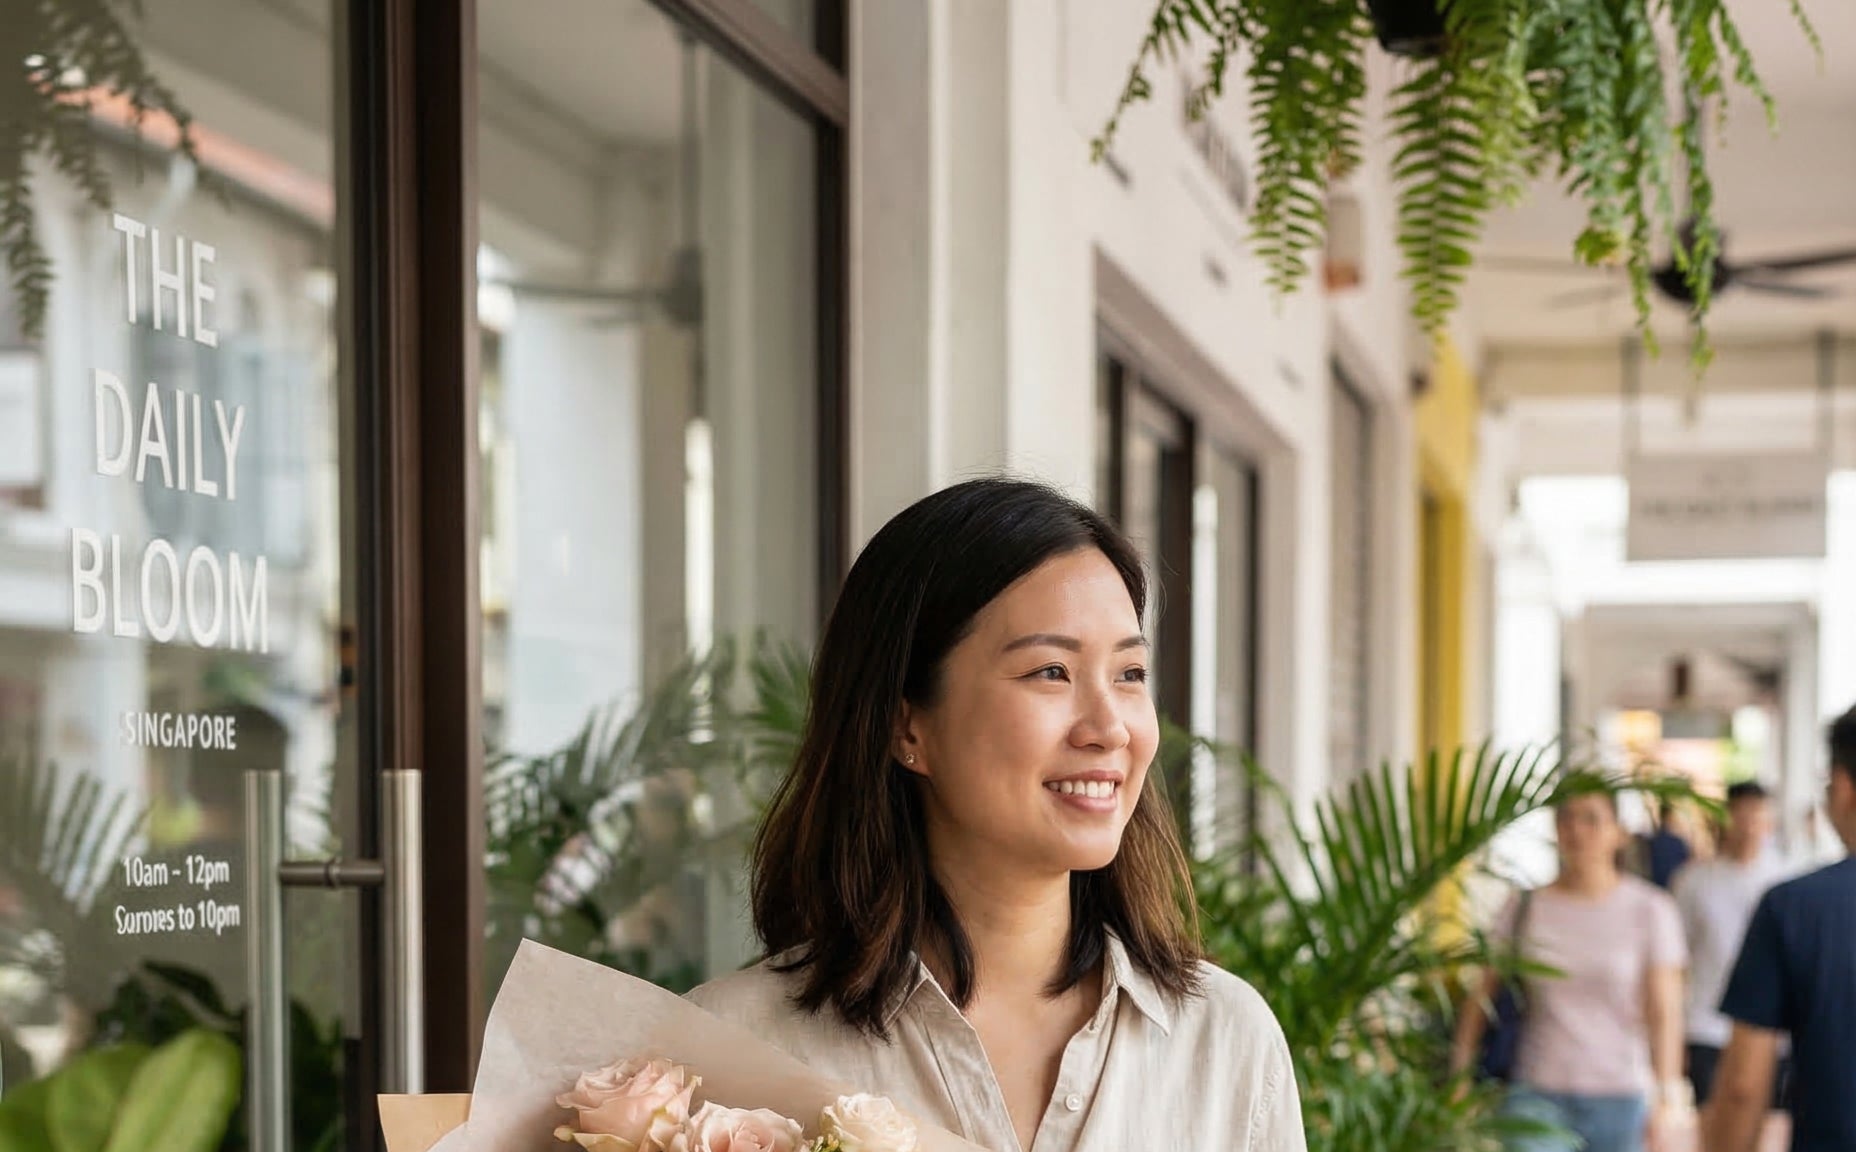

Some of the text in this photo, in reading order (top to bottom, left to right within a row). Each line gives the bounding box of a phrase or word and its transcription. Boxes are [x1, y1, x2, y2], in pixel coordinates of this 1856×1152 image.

[113, 213, 217, 347] THE
[94, 367, 246, 500] DAILY
[71, 527, 268, 653] BLOOM
[126, 711, 236, 749] SINGAPORE
[123, 856, 168, 887] 10am
[186, 855, 230, 890] 12pm
[178, 904, 195, 931] to
[198, 900, 241, 936] 10pm
